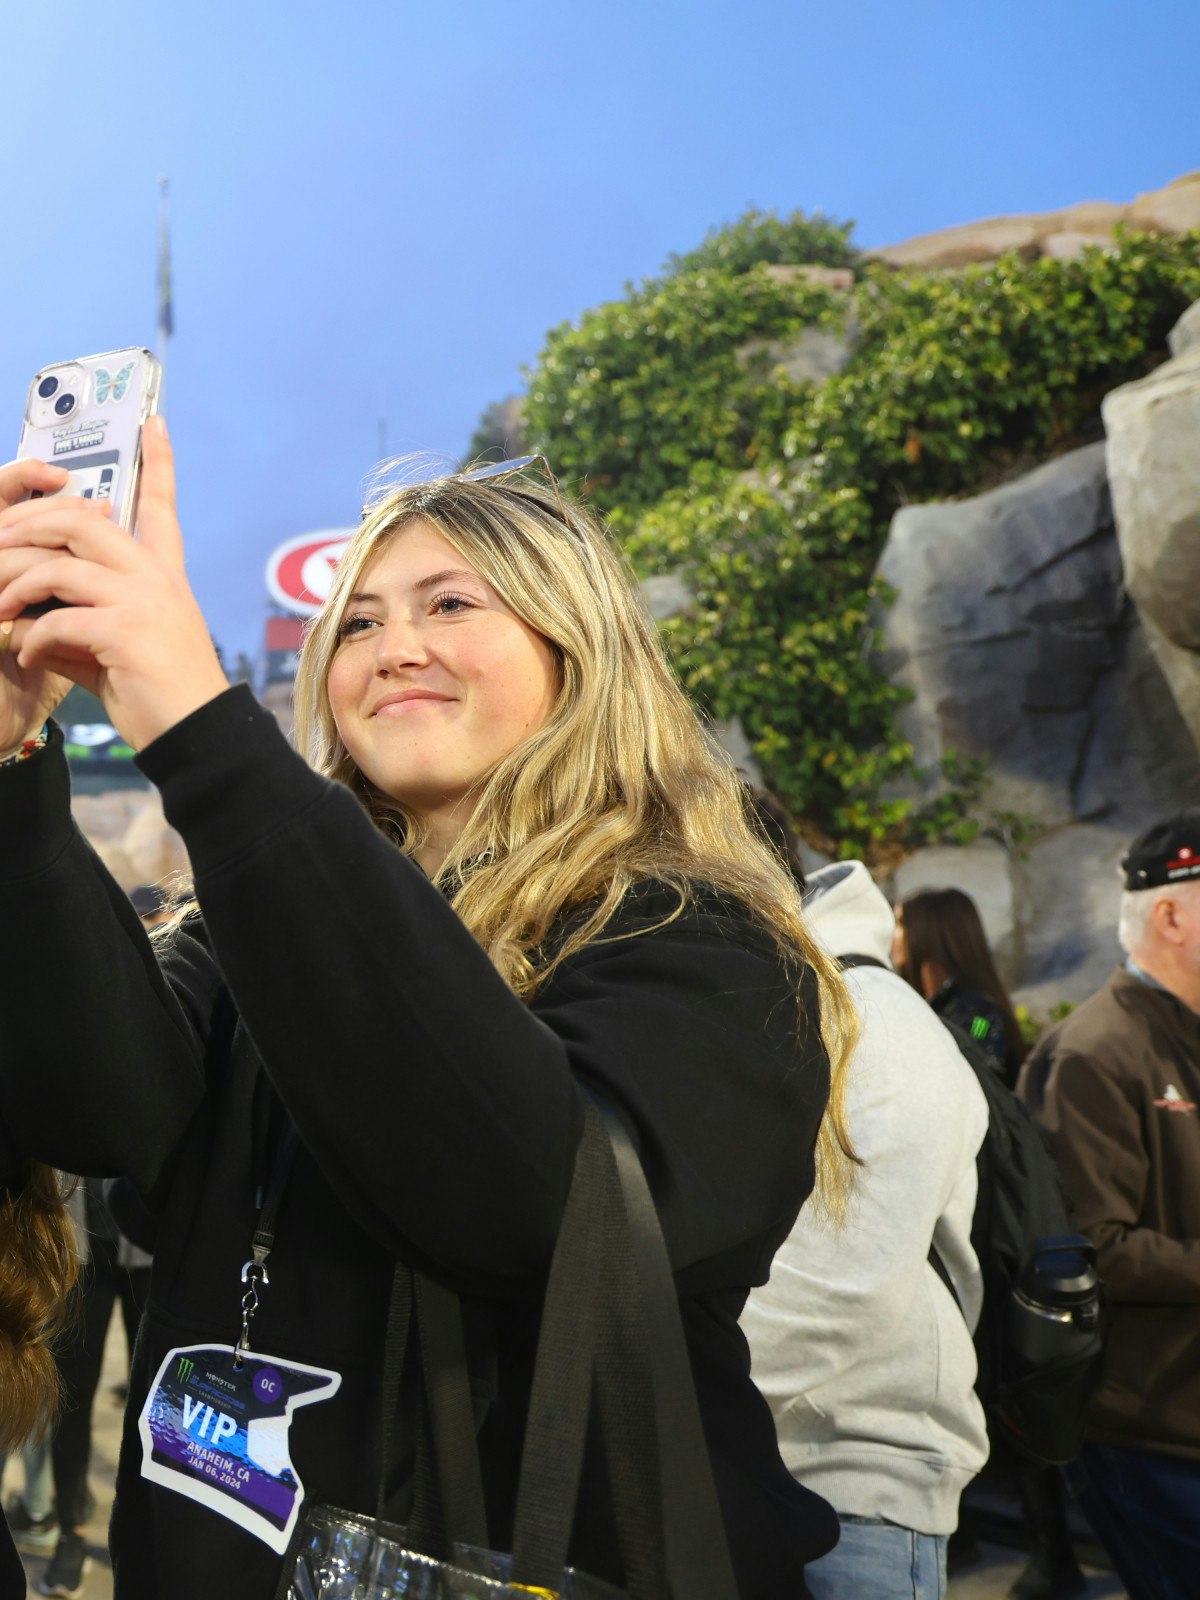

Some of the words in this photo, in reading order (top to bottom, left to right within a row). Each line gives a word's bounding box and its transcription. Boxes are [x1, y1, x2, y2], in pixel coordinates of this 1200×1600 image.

[260, 1378, 276, 1393] OC
[182, 1394, 238, 1445] VIP
[186, 1441, 235, 1476] ANAHEIM,
[236, 1467, 250, 1483] CA
[188, 1455, 205, 1470] JAN
[205, 1464, 219, 1479] 06,
[219, 1471, 242, 1490] 2024
